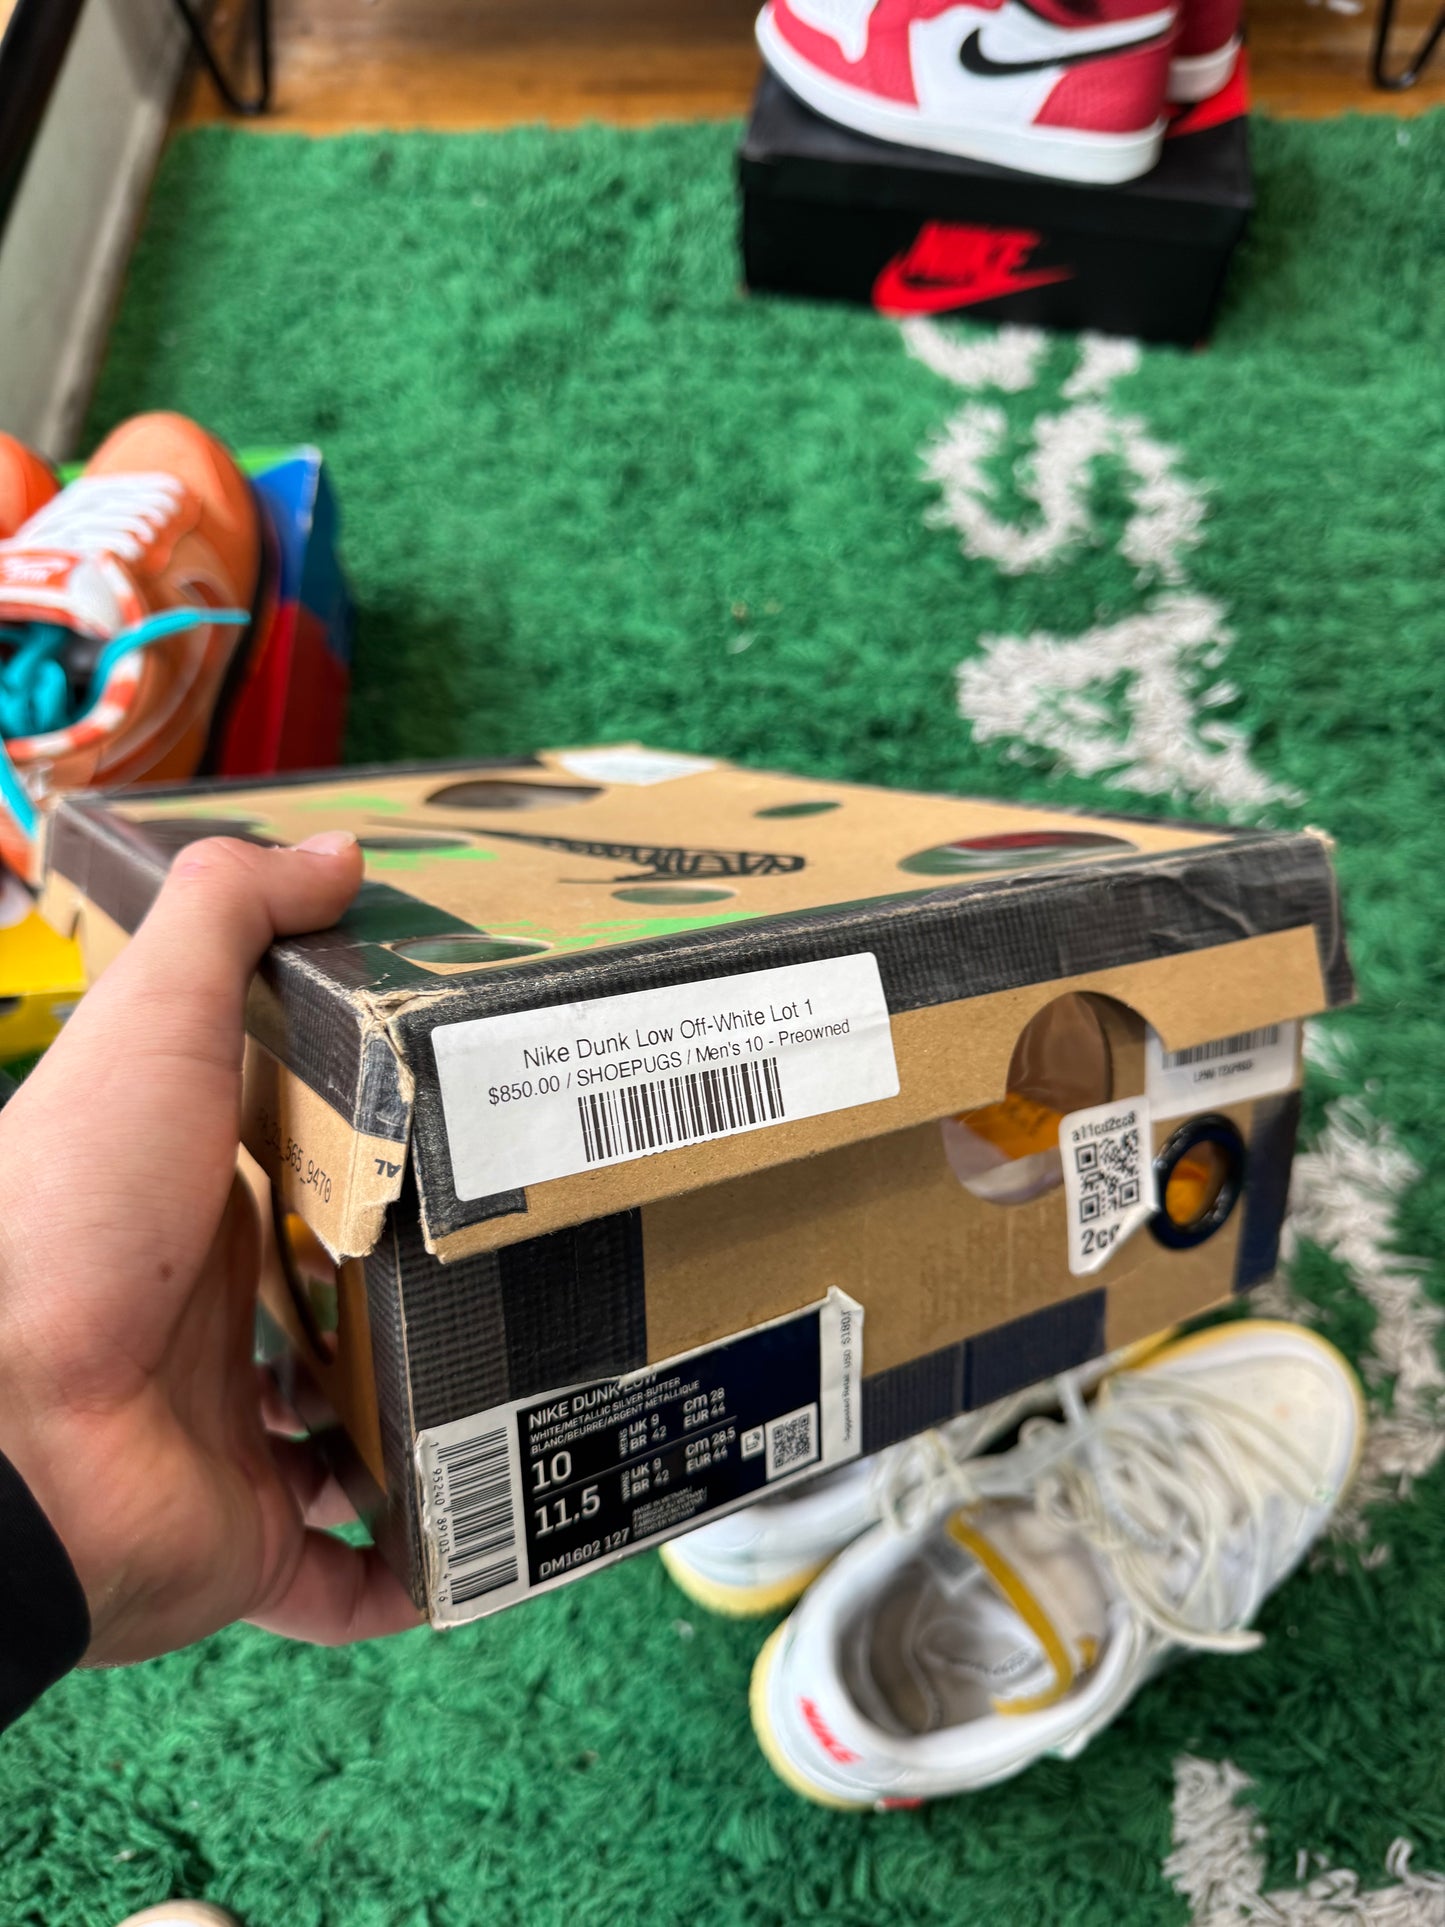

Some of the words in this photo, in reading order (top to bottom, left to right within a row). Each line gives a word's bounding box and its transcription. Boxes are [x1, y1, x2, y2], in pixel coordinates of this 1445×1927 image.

[523, 1045, 570, 1069] Nike
[576, 1032, 631, 1059] Dunk
[635, 1027, 674, 1048] Low
[680, 1009, 766, 1039] Off-White
[770, 1001, 800, 1023] Lot
[804, 998, 814, 1016] 1
[488, 1074, 561, 1106] $850.00
[576, 1051, 682, 1087] SHOEPUGS
[695, 1041, 741, 1064] Men's
[745, 1035, 764, 1053] 10
[778, 1018, 851, 1046] Preowned
[842, 1349, 852, 1369] USD
[528, 1400, 570, 1431] NIKE
[571, 1383, 621, 1412] DUNK
[529, 1404, 611, 1444] WHITE/METALLIC
[611, 1377, 682, 1412] SILVER-BUTTER
[530, 1402, 643, 1457] BLANC/BEURRE/ARGENT
[644, 1379, 701, 1410] METALLIQUE
[683, 1393, 709, 1416] cm
[709, 1386, 726, 1403] 28
[683, 1410, 710, 1432] EUR
[710, 1401, 727, 1418] 44
[628, 1418, 648, 1436] UK
[650, 1413, 661, 1428] 9
[629, 1434, 648, 1453] BR
[651, 1425, 668, 1442] 42
[685, 1436, 710, 1459] cm
[711, 1425, 737, 1446] 28.5
[531, 1450, 573, 1494] 10
[630, 1463, 650, 1480] UK
[651, 1457, 662, 1472] 9
[686, 1453, 712, 1475] EUR
[712, 1446, 729, 1462] 44
[433, 1468, 446, 1506] 95240
[631, 1478, 649, 1497] BR
[653, 1469, 670, 1486] 42
[534, 1484, 601, 1539] 11.5
[437, 1517, 450, 1554] 89103
[539, 1539, 602, 1579] DM1602
[603, 1526, 631, 1551] 127
